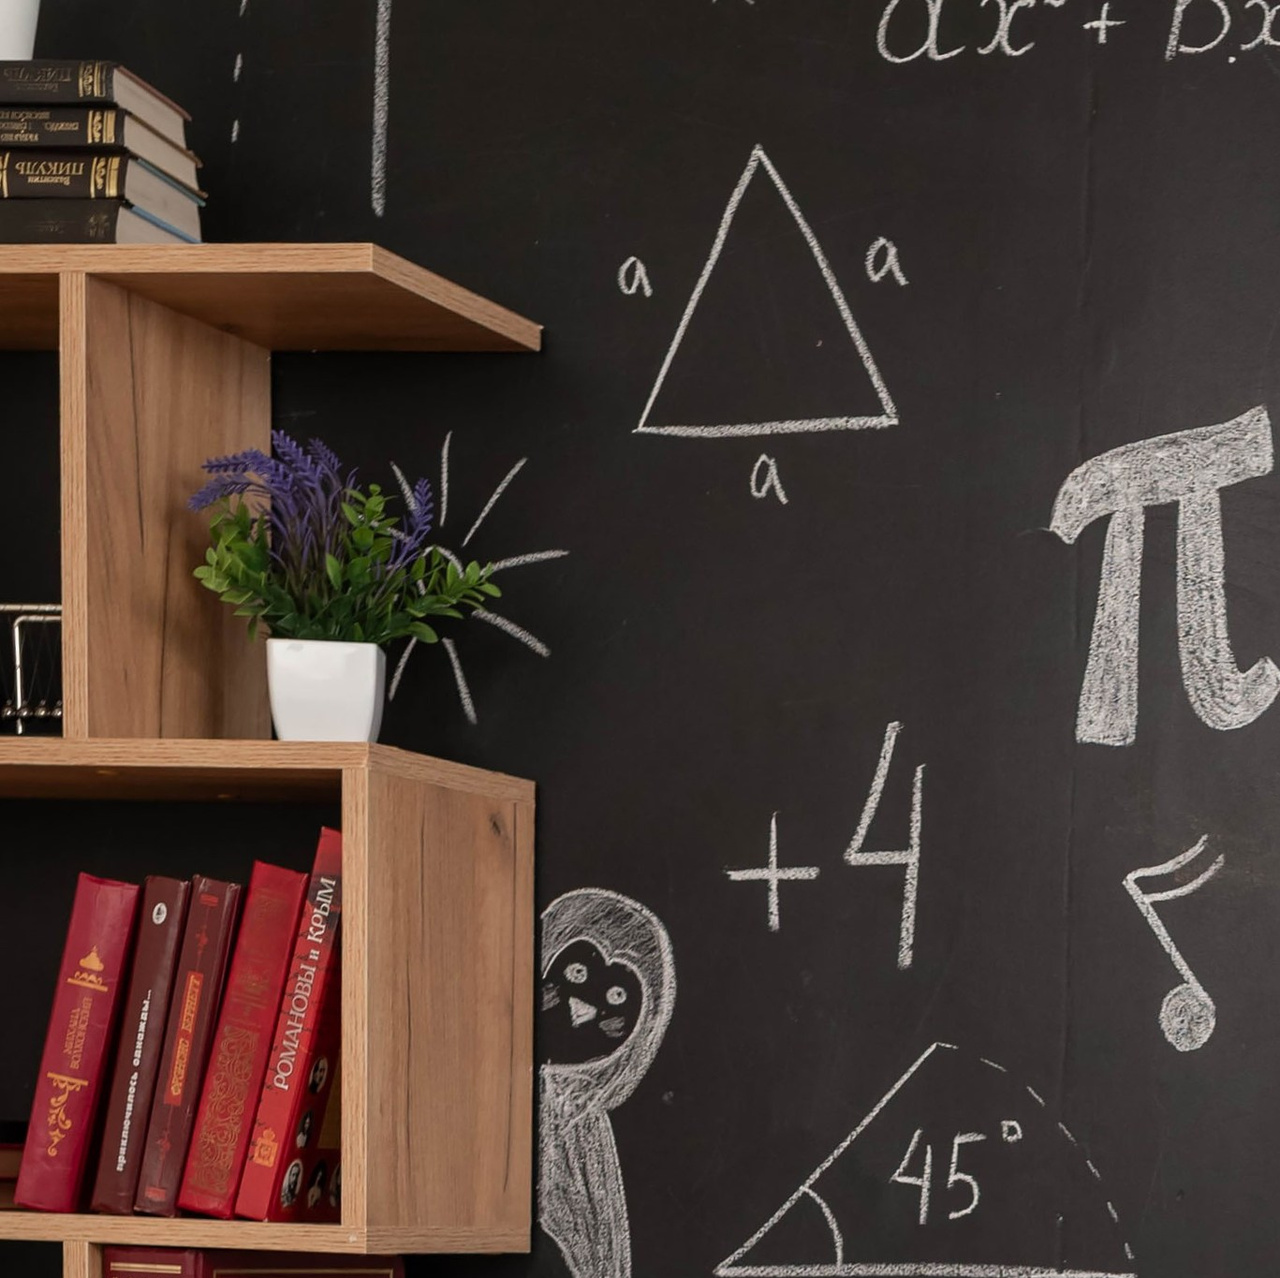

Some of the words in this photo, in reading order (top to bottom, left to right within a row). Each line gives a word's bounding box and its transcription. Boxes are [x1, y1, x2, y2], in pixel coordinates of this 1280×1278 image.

[14, 161, 86, 176] ПИКУЛЬ
[617, 255, 654, 298] a
[864, 236, 910, 286] a
[748, 452, 789, 506] a
[273, 963, 317, 1091] РОМАНОВЫ
[306, 876, 337, 945] КРЫМ
[116, 1070, 139, 1172] приключилось
